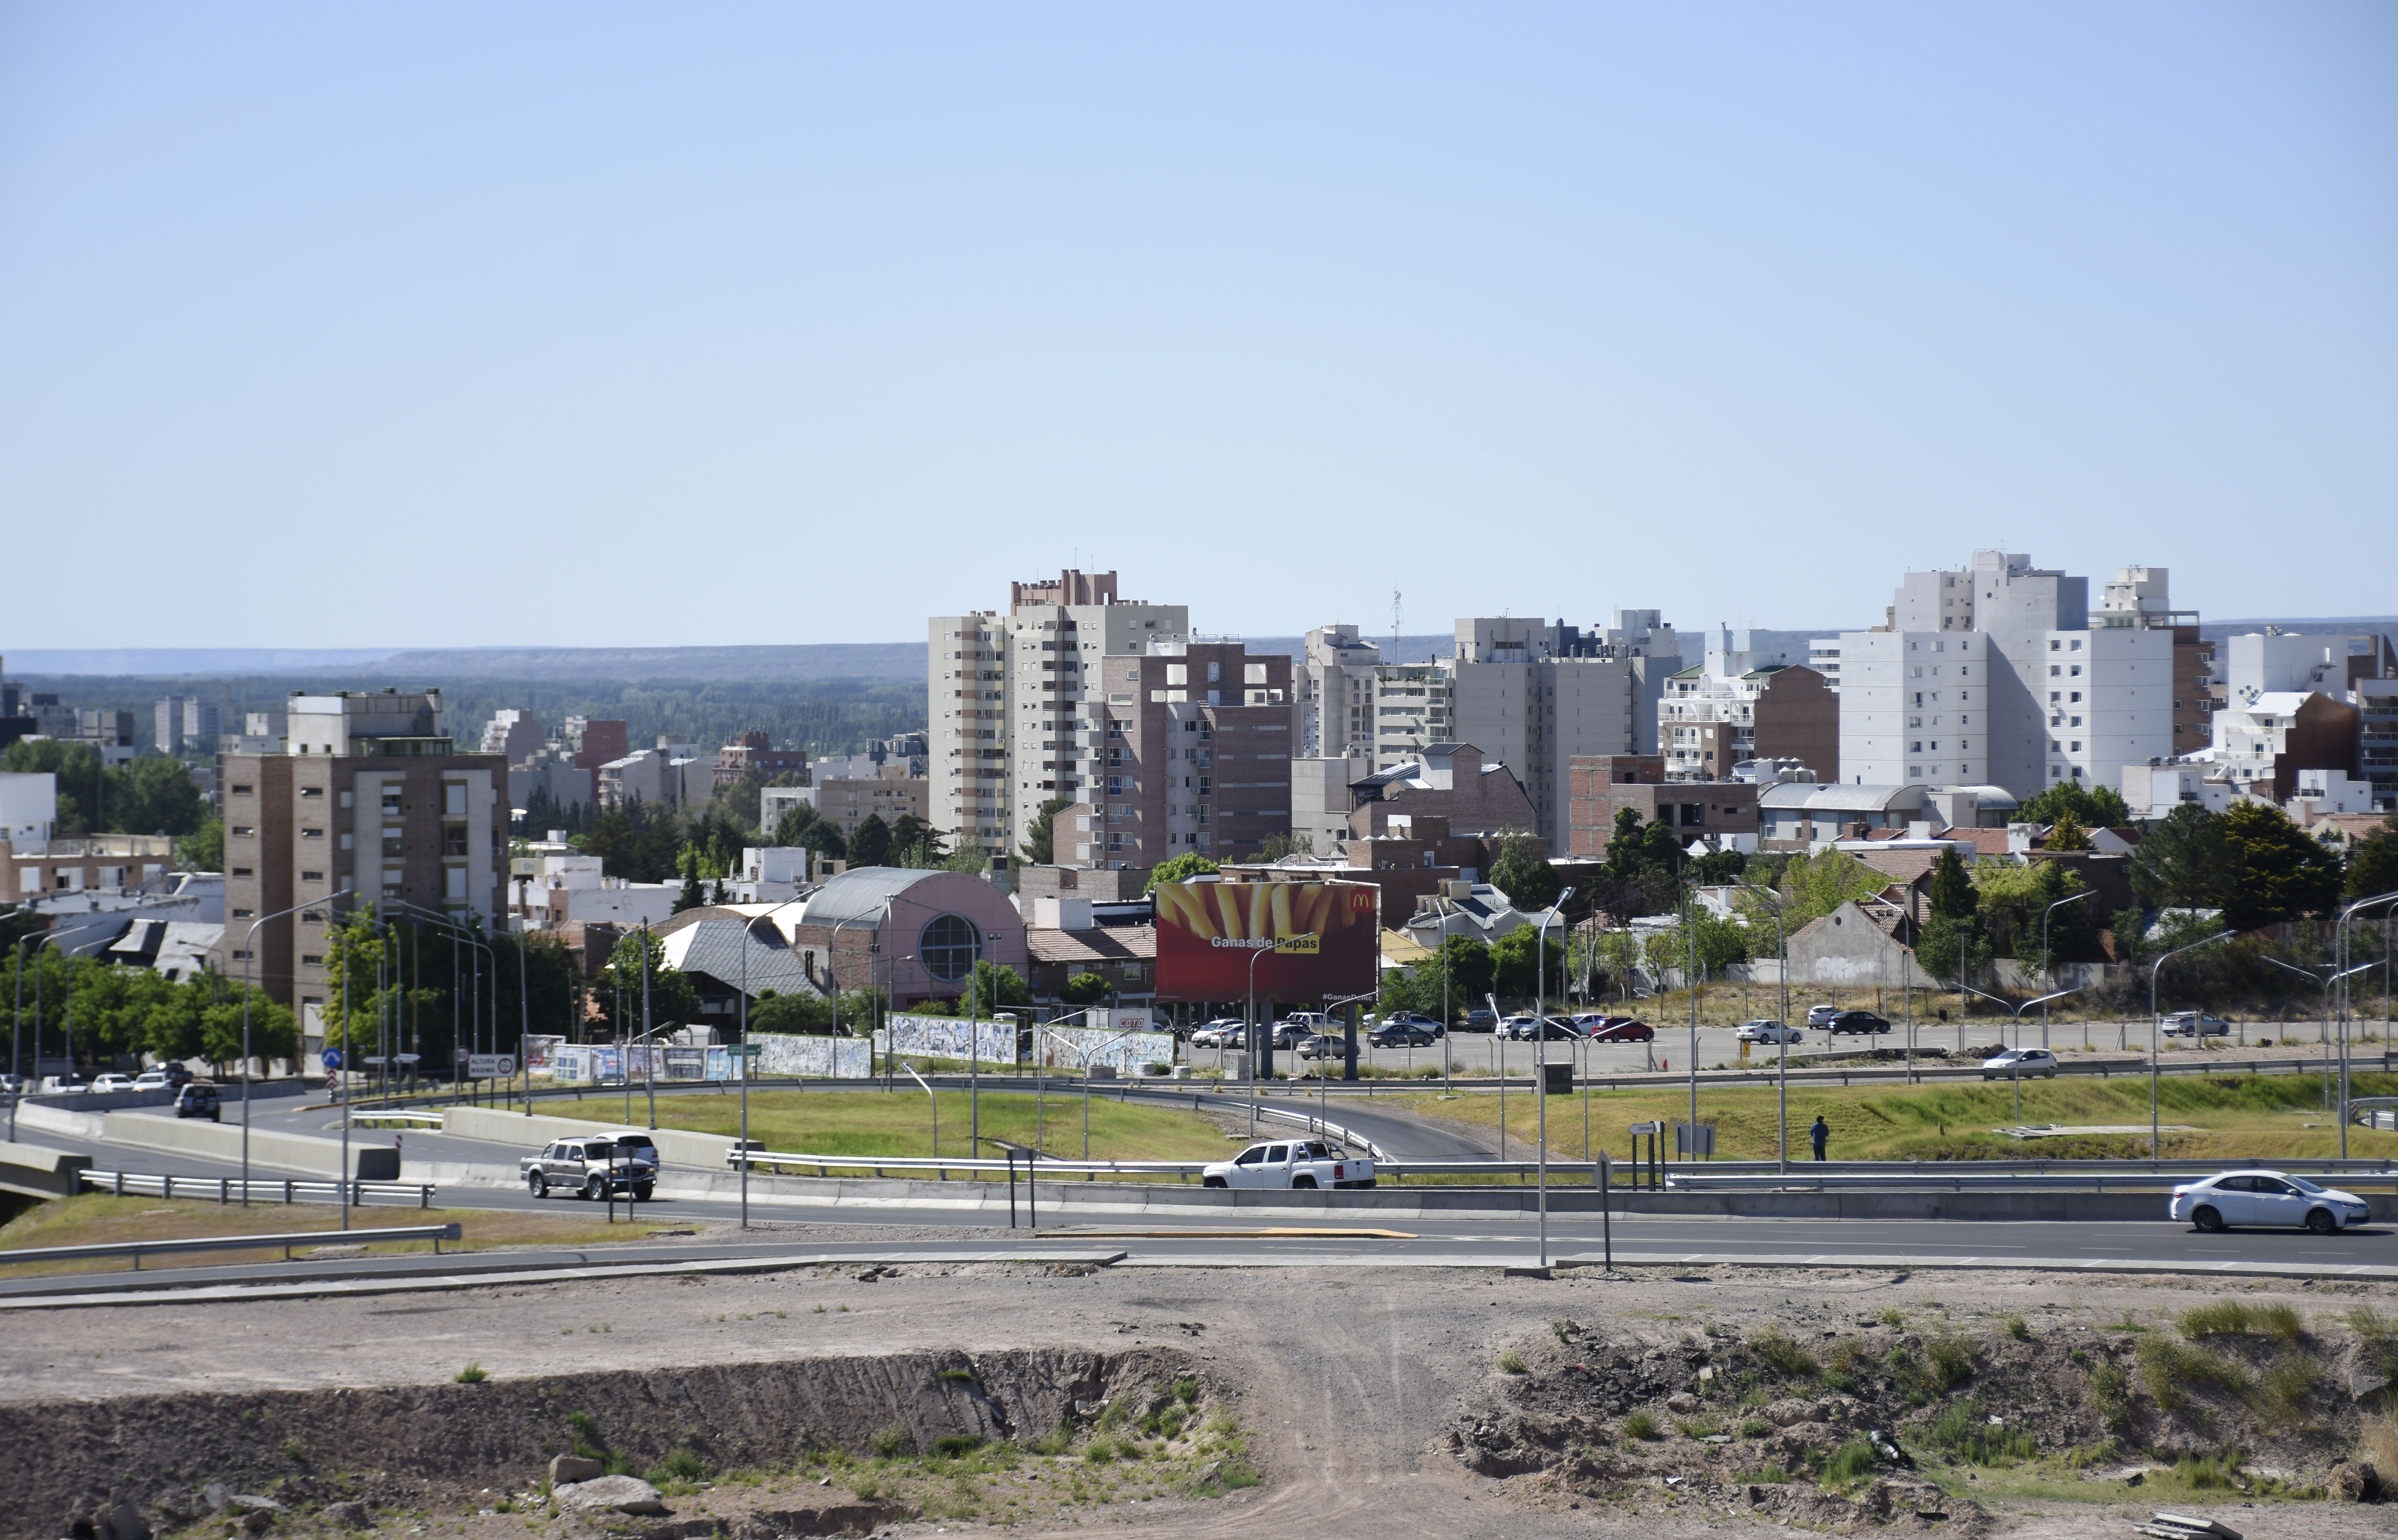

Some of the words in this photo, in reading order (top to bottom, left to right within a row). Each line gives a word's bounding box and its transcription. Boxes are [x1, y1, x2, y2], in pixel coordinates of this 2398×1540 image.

[1211, 936, 1253, 948] Ganas
[1257, 937, 1273, 948] de
[1277, 937, 1317, 951] Papas
[1119, 1018, 1144, 1028] COTO
